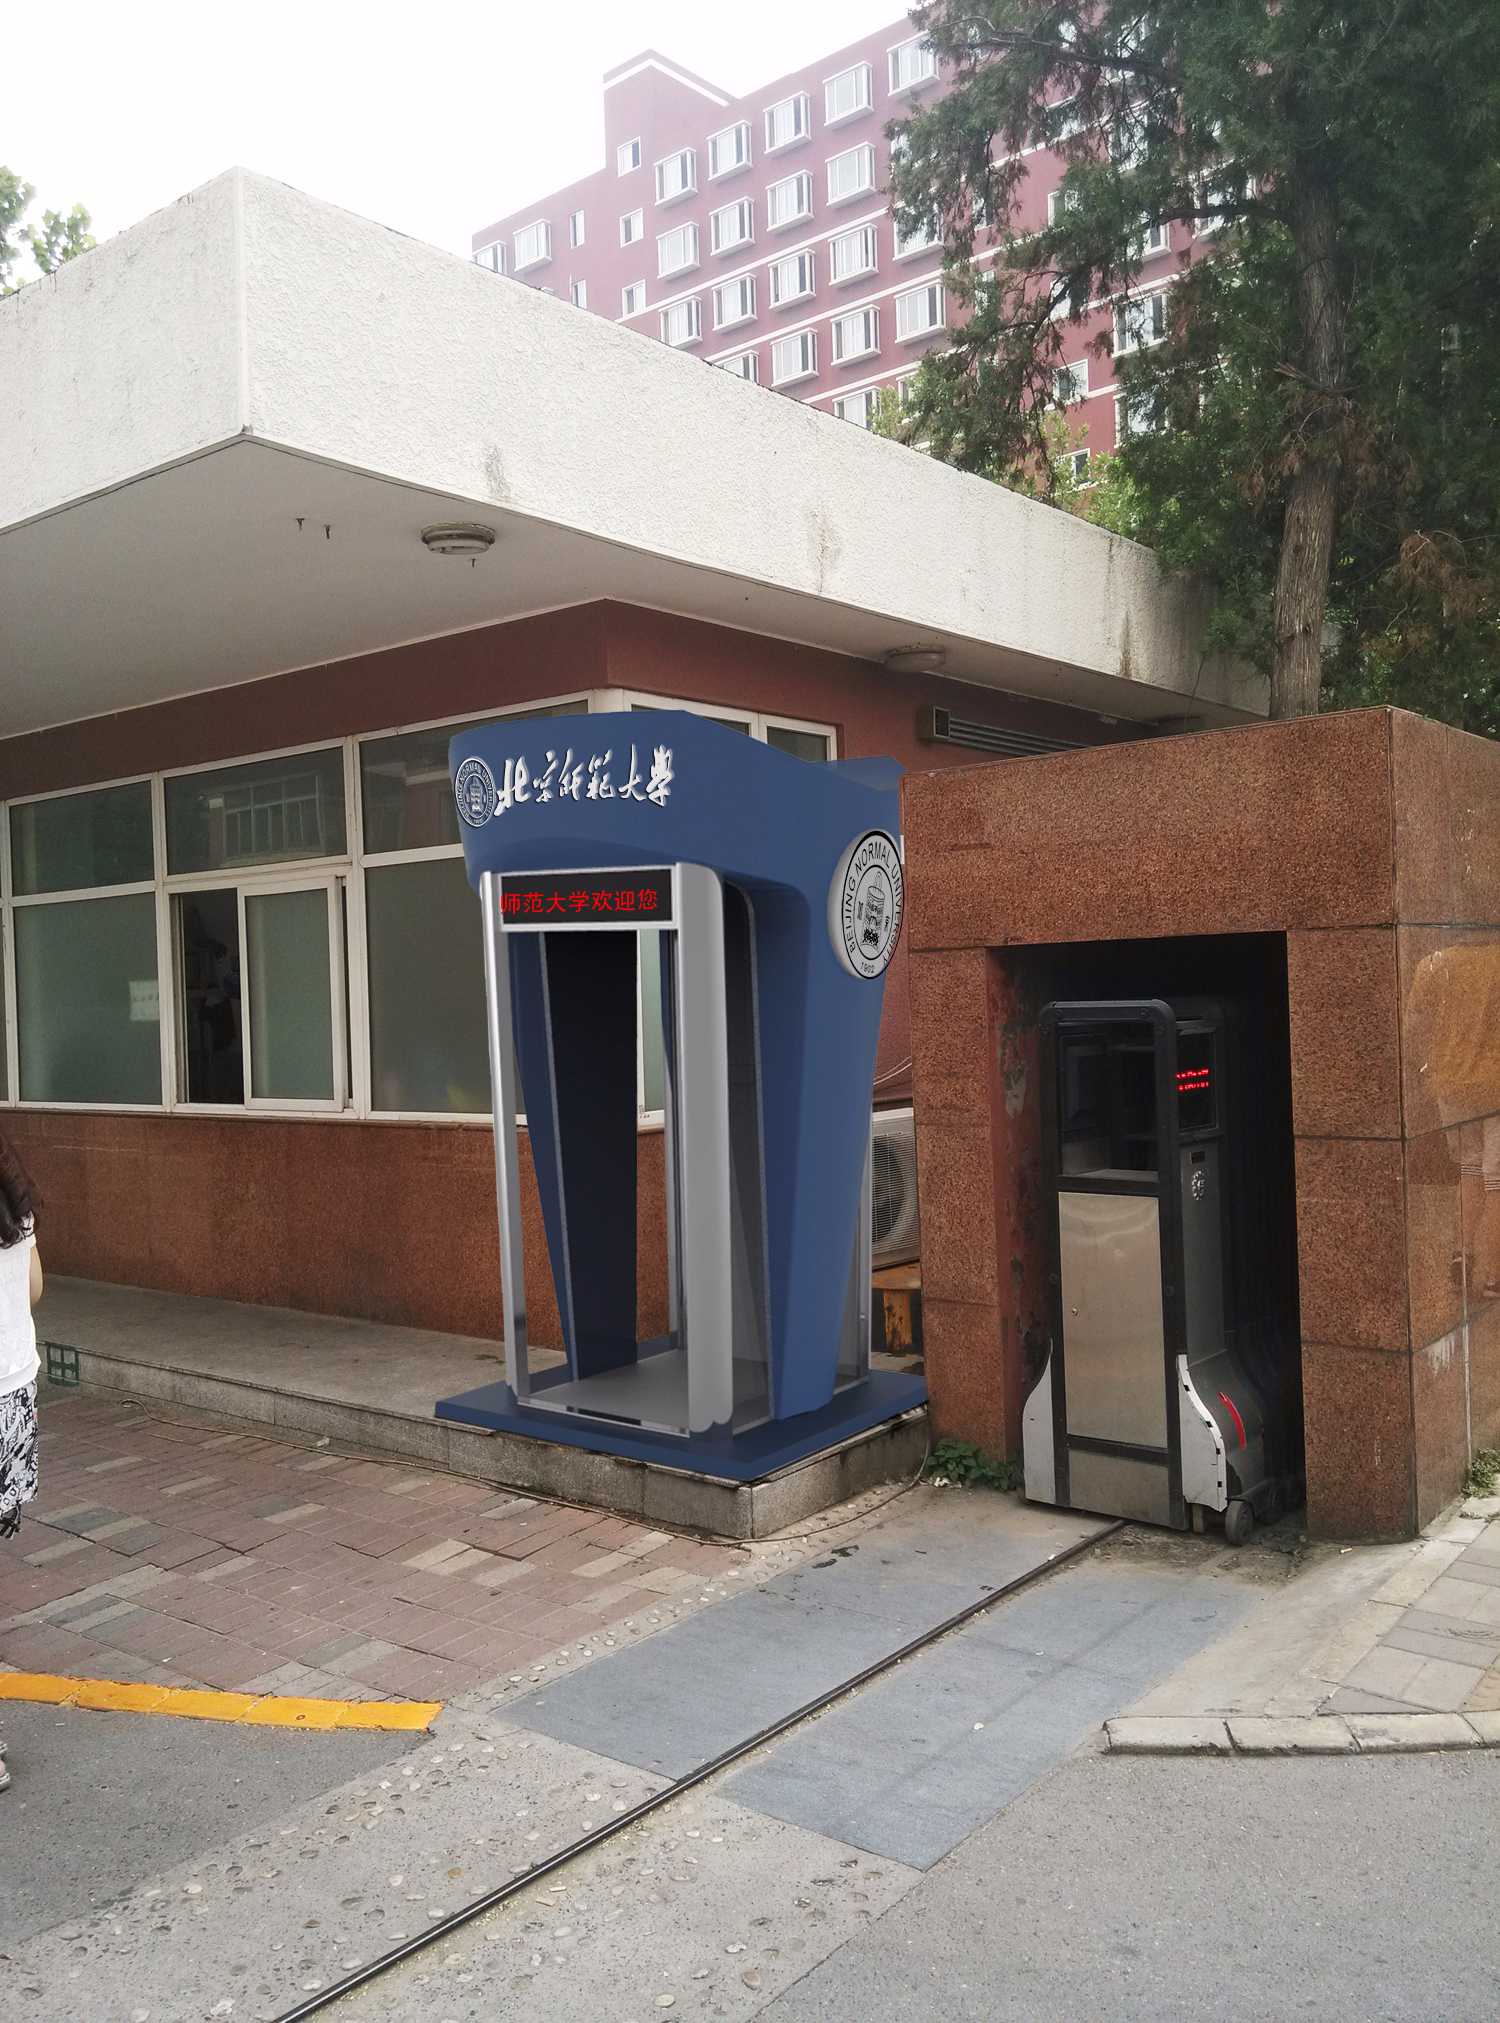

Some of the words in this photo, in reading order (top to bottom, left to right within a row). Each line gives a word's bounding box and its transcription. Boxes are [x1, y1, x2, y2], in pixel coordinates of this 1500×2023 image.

[500, 888, 657, 915] 师范大学欢迎您
[845, 876, 856, 953] BEIJING
[855, 842, 890, 876] NORMAL
[884, 864, 903, 968] UNIVERSITY
